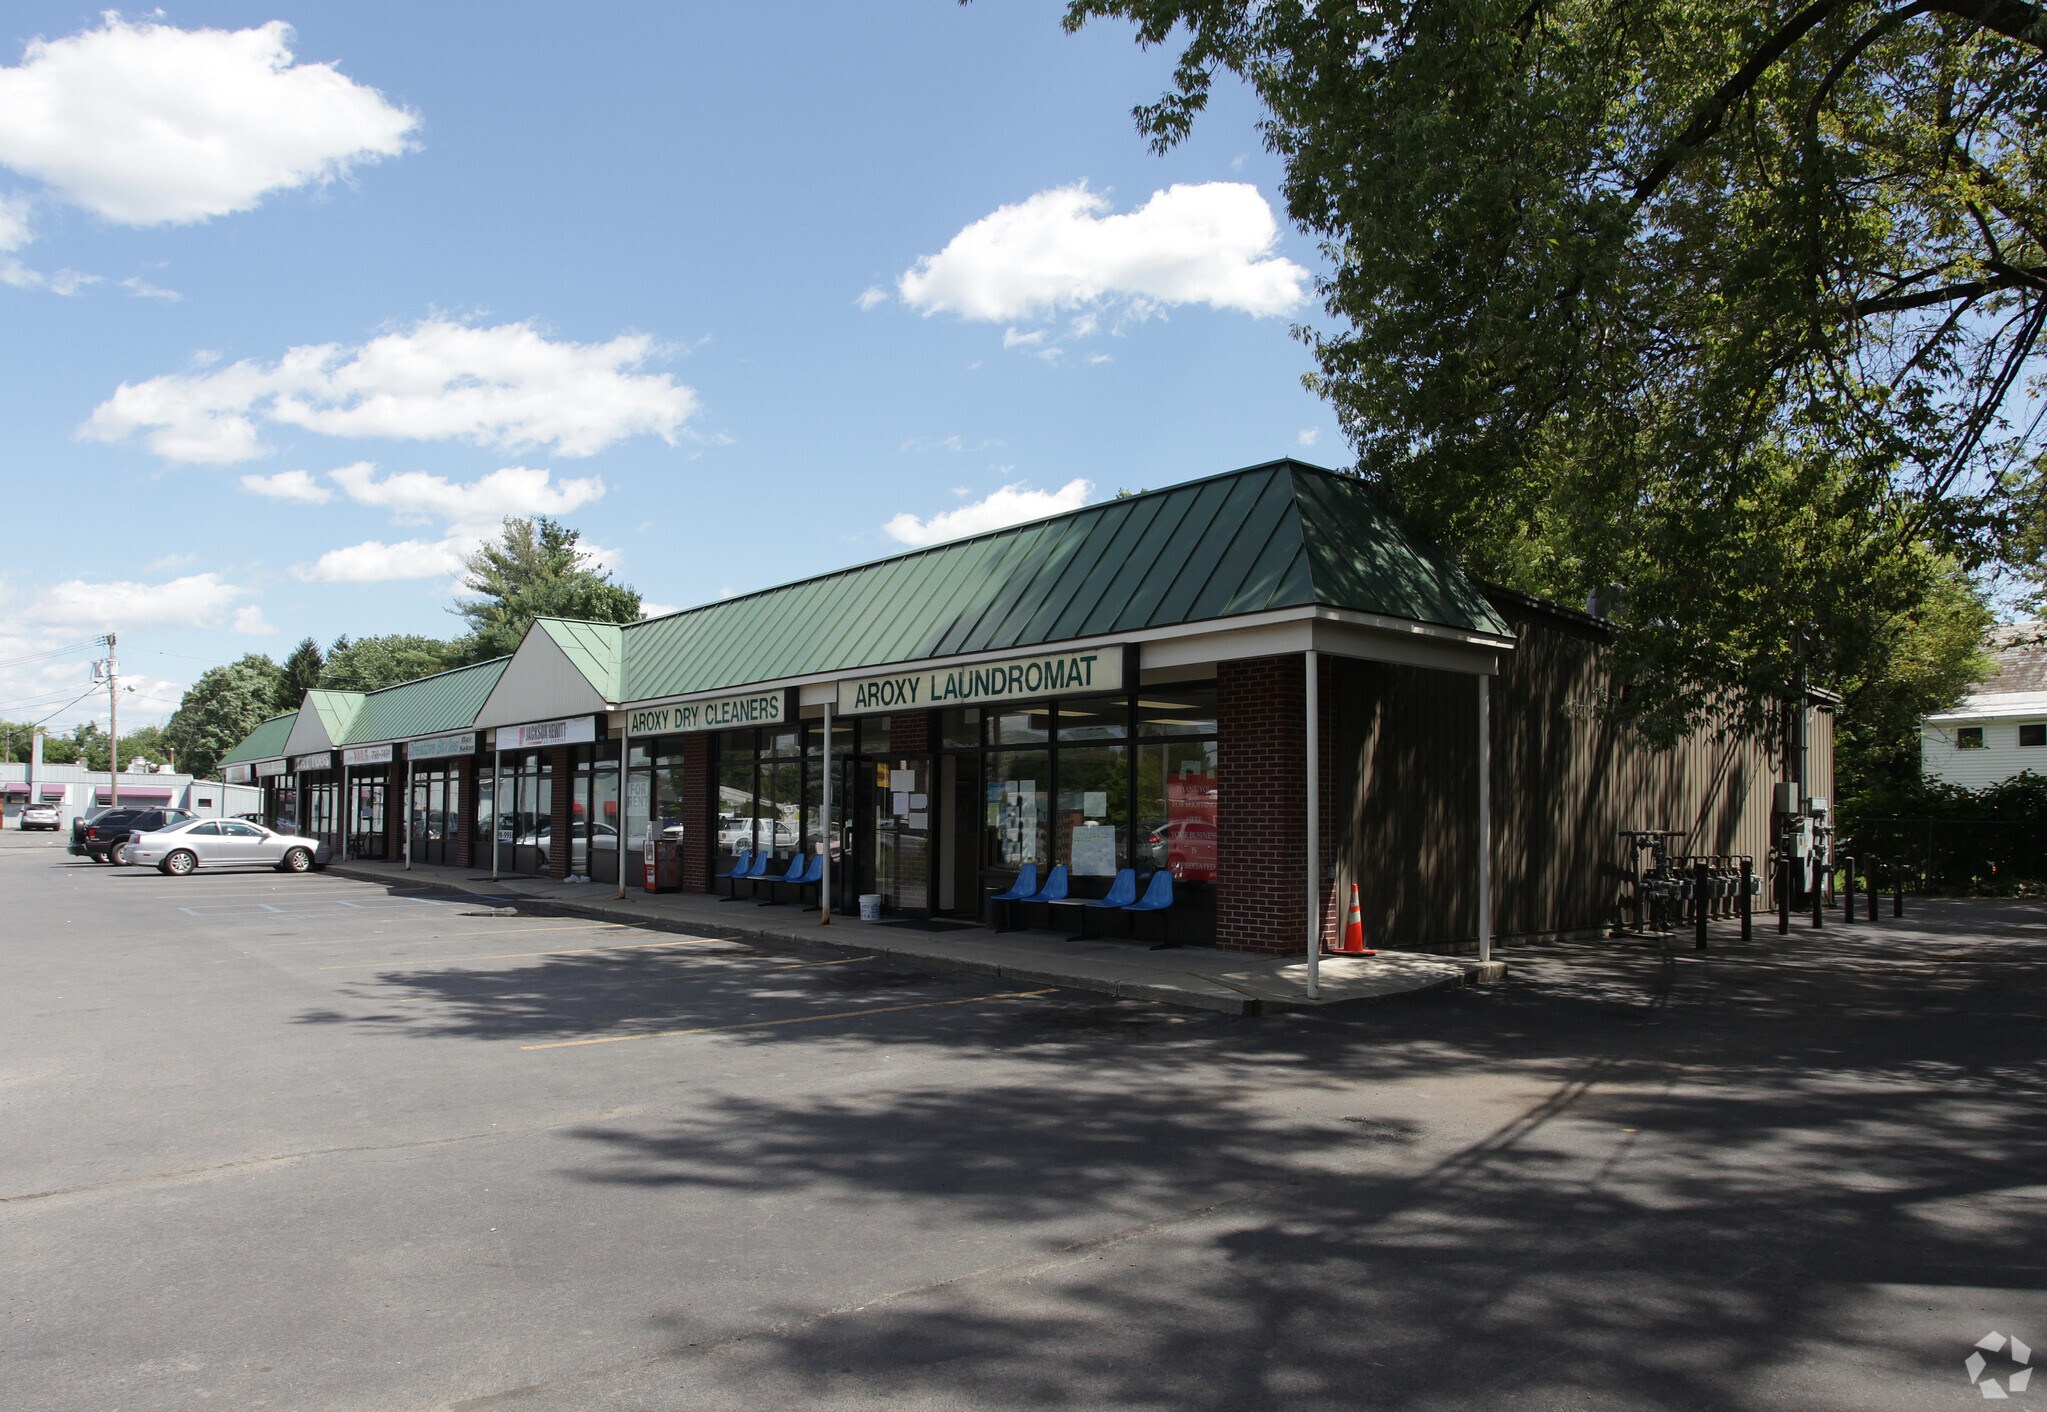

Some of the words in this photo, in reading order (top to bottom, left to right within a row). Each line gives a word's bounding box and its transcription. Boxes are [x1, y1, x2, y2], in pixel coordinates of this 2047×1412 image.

[854, 677, 921, 709] AROXY
[930, 655, 1098, 702] LAUNDROMAT
[631, 710, 669, 733] AROXY
[674, 705, 699, 729] DRY
[705, 695, 779, 726] CLEANERS
[525, 724, 548, 742] JACKSON
[548, 721, 567, 740] HEWITT
[629, 780, 648, 796] FOR
[1176, 785, 1199, 794] THANK
[627, 795, 649, 810] RENT
[1186, 816, 1203, 824] HERE
[1190, 831, 1218, 840] BUSINESS
[1191, 847, 1198, 855] IS
